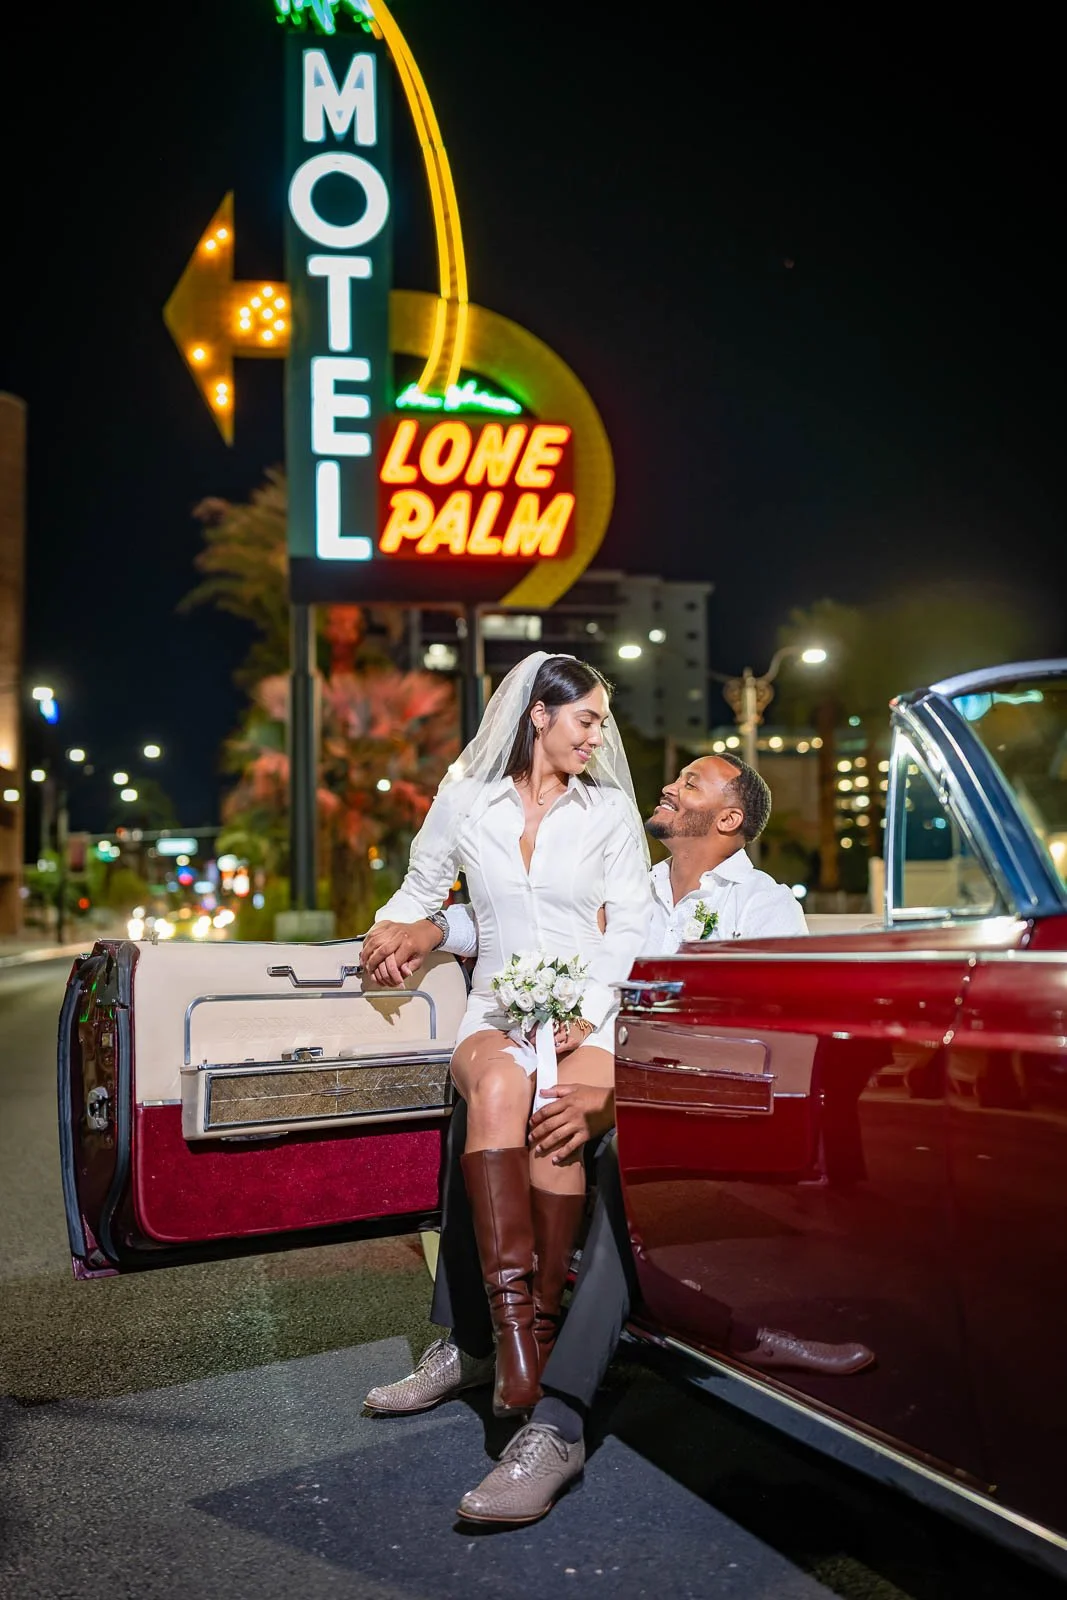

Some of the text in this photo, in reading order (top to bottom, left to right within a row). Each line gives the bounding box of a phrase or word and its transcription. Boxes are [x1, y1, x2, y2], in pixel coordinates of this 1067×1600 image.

[289, 48, 390, 561] MOTEL
[380, 419, 572, 488] LONE
[379, 489, 576, 557] PALM
